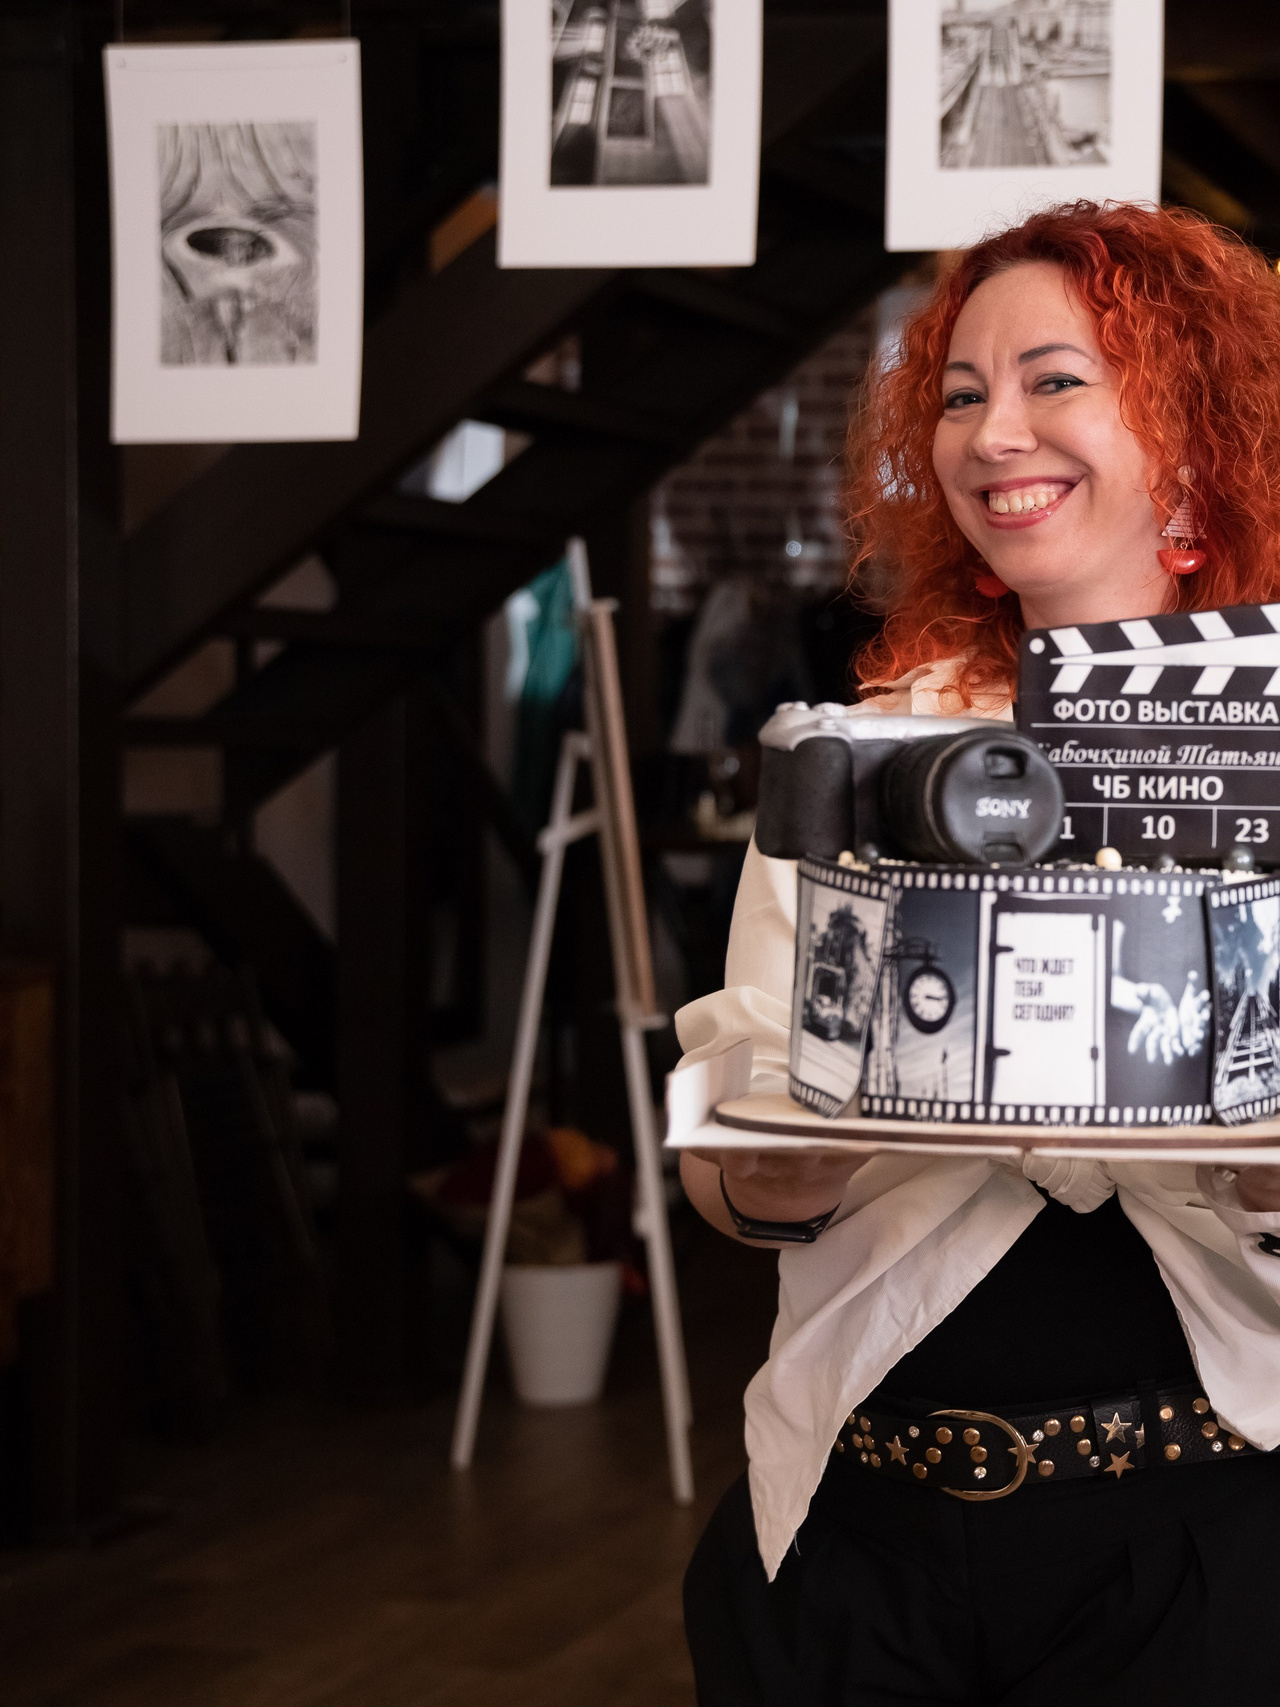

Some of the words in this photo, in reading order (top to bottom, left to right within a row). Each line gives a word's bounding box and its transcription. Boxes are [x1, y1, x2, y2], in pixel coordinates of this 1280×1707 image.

[1053, 698, 1132, 722] ФОТО
[1137, 700, 1280, 724] ВЫСТАВКА
[1038, 739, 1171, 769] абочкиной
[1092, 774, 1132, 799] ЧБ
[1138, 776, 1225, 801] КИНО
[974, 796, 1032, 820] SONY
[1140, 815, 1177, 840] 10
[1234, 818, 1270, 844] 23
